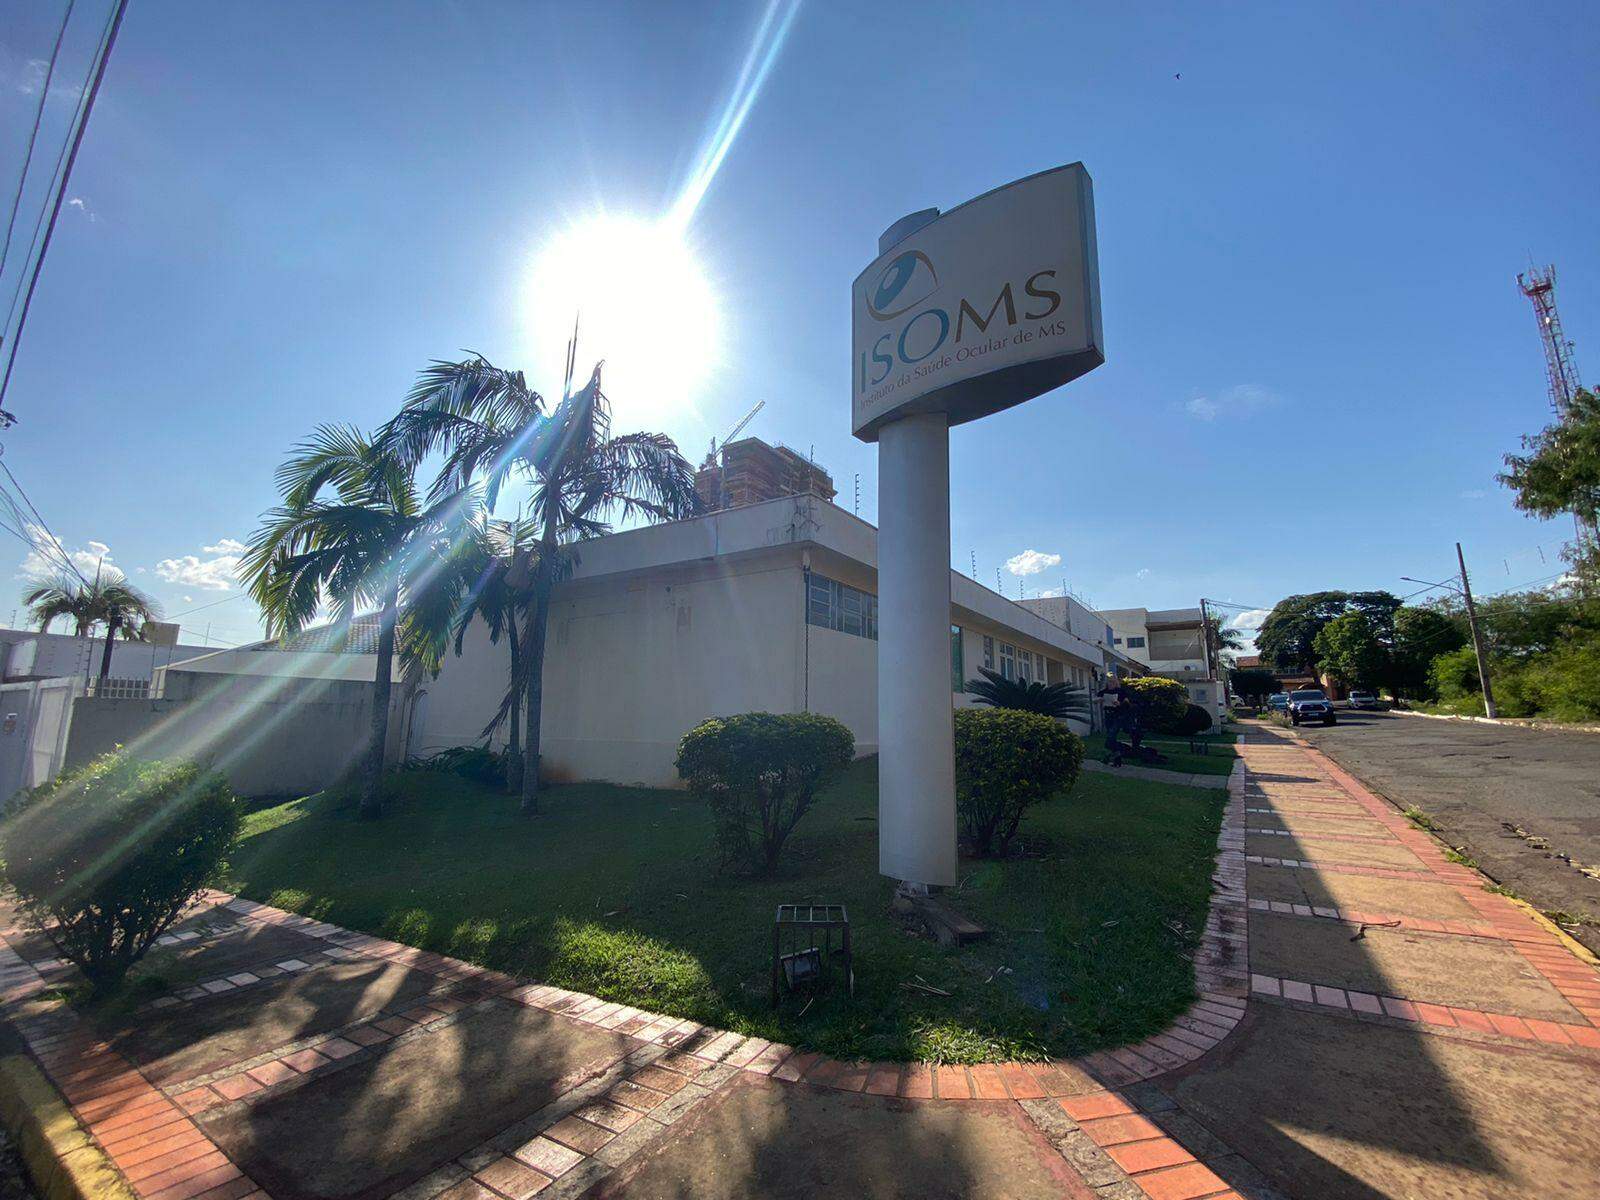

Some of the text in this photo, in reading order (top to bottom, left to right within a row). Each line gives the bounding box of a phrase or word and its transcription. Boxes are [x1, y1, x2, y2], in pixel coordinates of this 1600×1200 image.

[861, 270, 1061, 393] ISOMS
[897, 374, 911, 387] da
[914, 355, 951, 378] Saúde
[956, 338, 1008, 361] Ocular
[1013, 330, 1033, 345] de
[1039, 320, 1066, 338] MS
